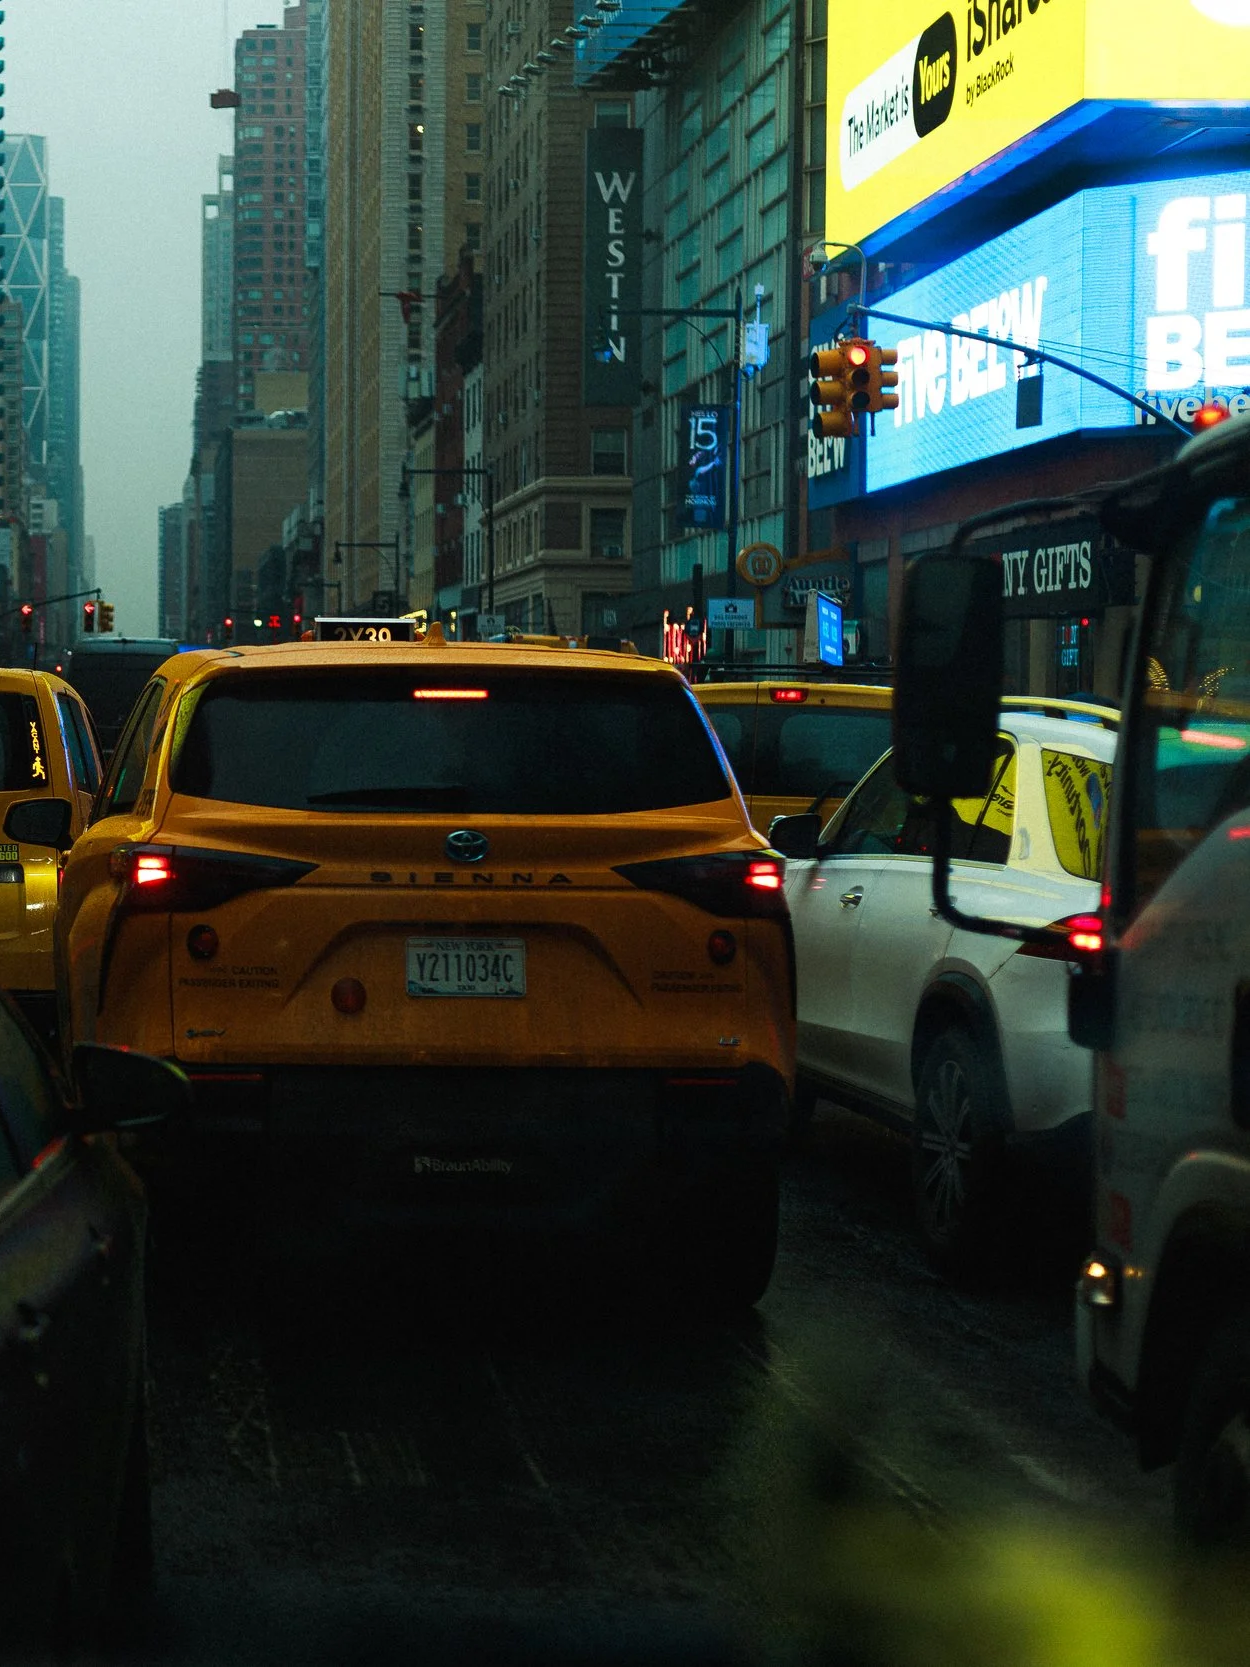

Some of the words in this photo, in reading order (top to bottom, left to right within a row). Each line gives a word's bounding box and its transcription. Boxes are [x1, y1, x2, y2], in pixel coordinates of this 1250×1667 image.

[967, 0, 1052, 62] iShar
[848, 115, 865, 157] The
[866, 86, 900, 145] Market
[901, 75, 909, 117] is
[919, 51, 951, 105] Yours
[966, 83, 976, 107] by
[976, 52, 1014, 98] BlackRock
[594, 171, 636, 363] WESTIN
[1146, 194, 1247, 313] fi
[1145, 308, 1250, 391] BE
[894, 329, 947, 428] five
[689, 417, 718, 450] 15
[1033, 541, 1092, 595] GIFTS
[30, 721, 40, 754] VACANT
[370, 872, 573, 884] SIENNA
[232, 966, 278, 975] CAUTION
[416, 953, 514, 983] Y211034C
[436, 941, 461, 951] NEW
[464, 941, 495, 951] YORK
[432, 1158, 514, 1175] BraunAbility
